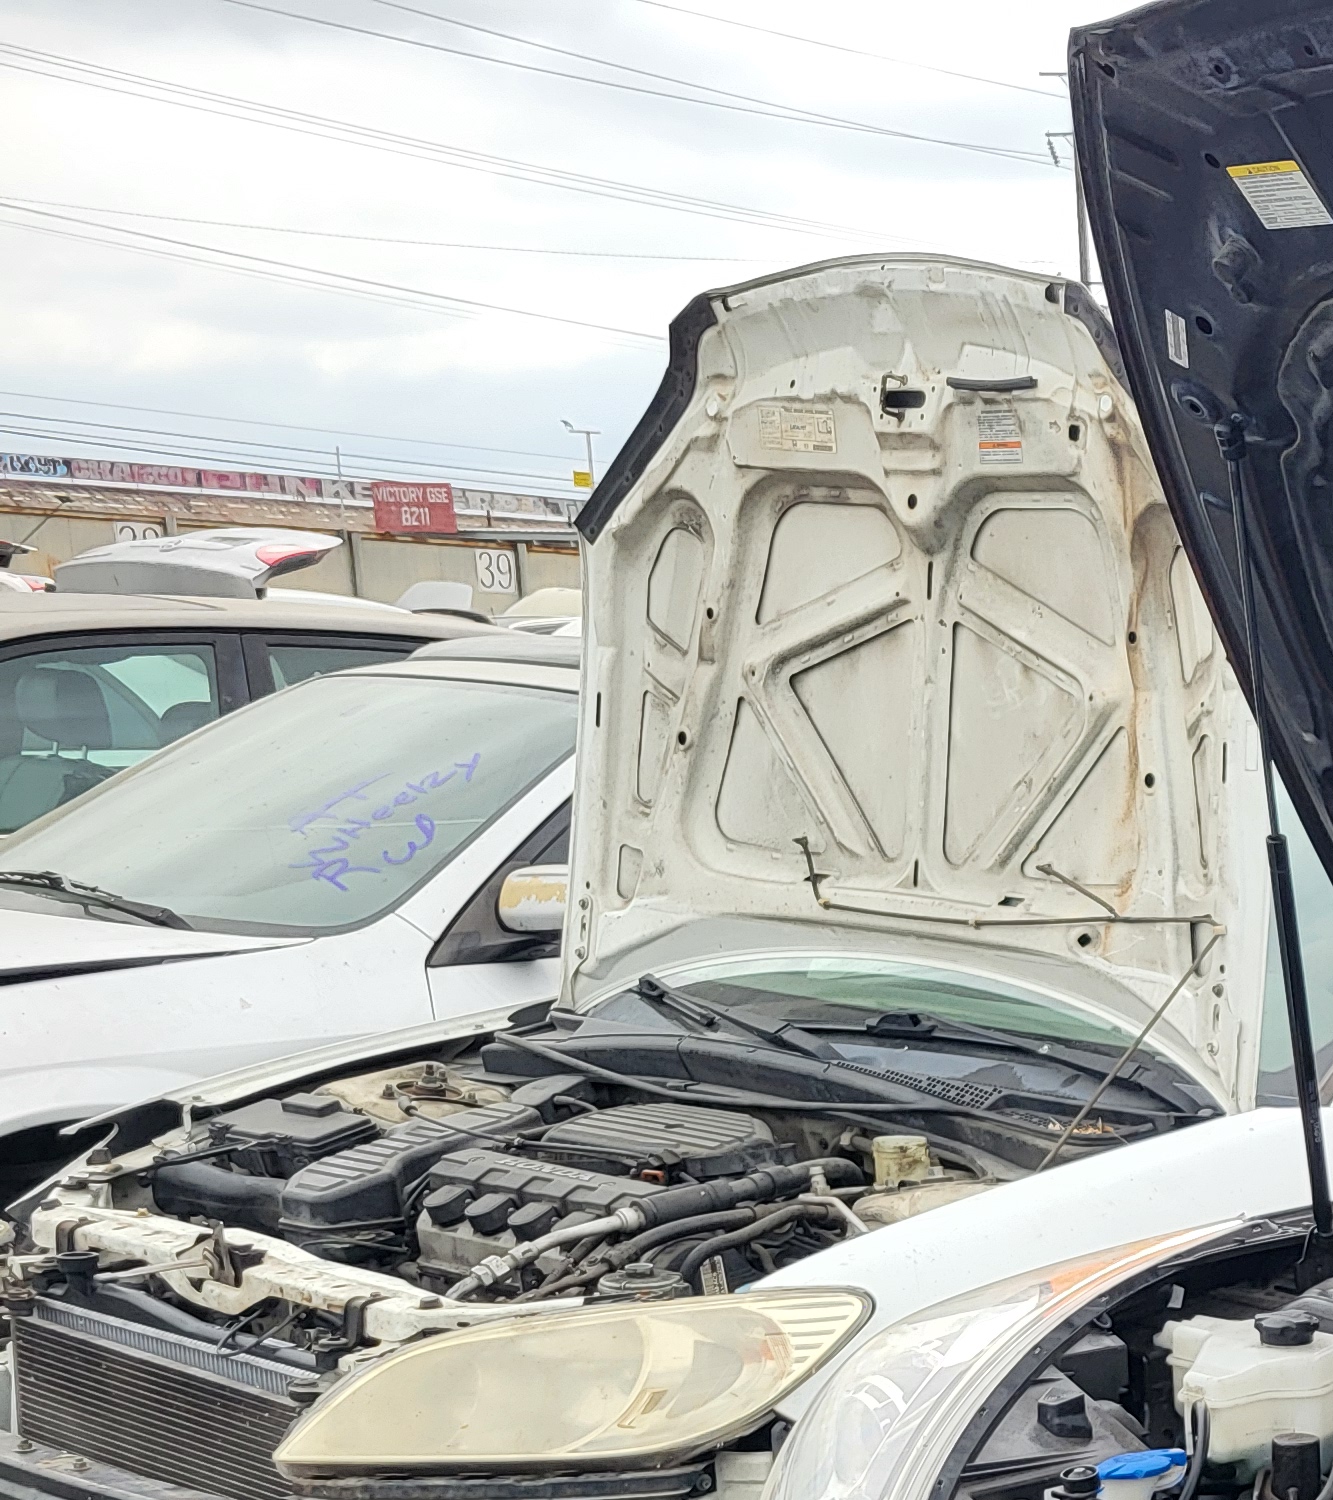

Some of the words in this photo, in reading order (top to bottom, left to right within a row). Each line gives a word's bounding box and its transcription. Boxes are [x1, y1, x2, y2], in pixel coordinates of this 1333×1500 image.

[373, 487, 424, 503] VICTORY
[426, 487, 450, 503] GSE
[478, 551, 513, 590] 39
[494, 1158, 596, 1182] HONDA
